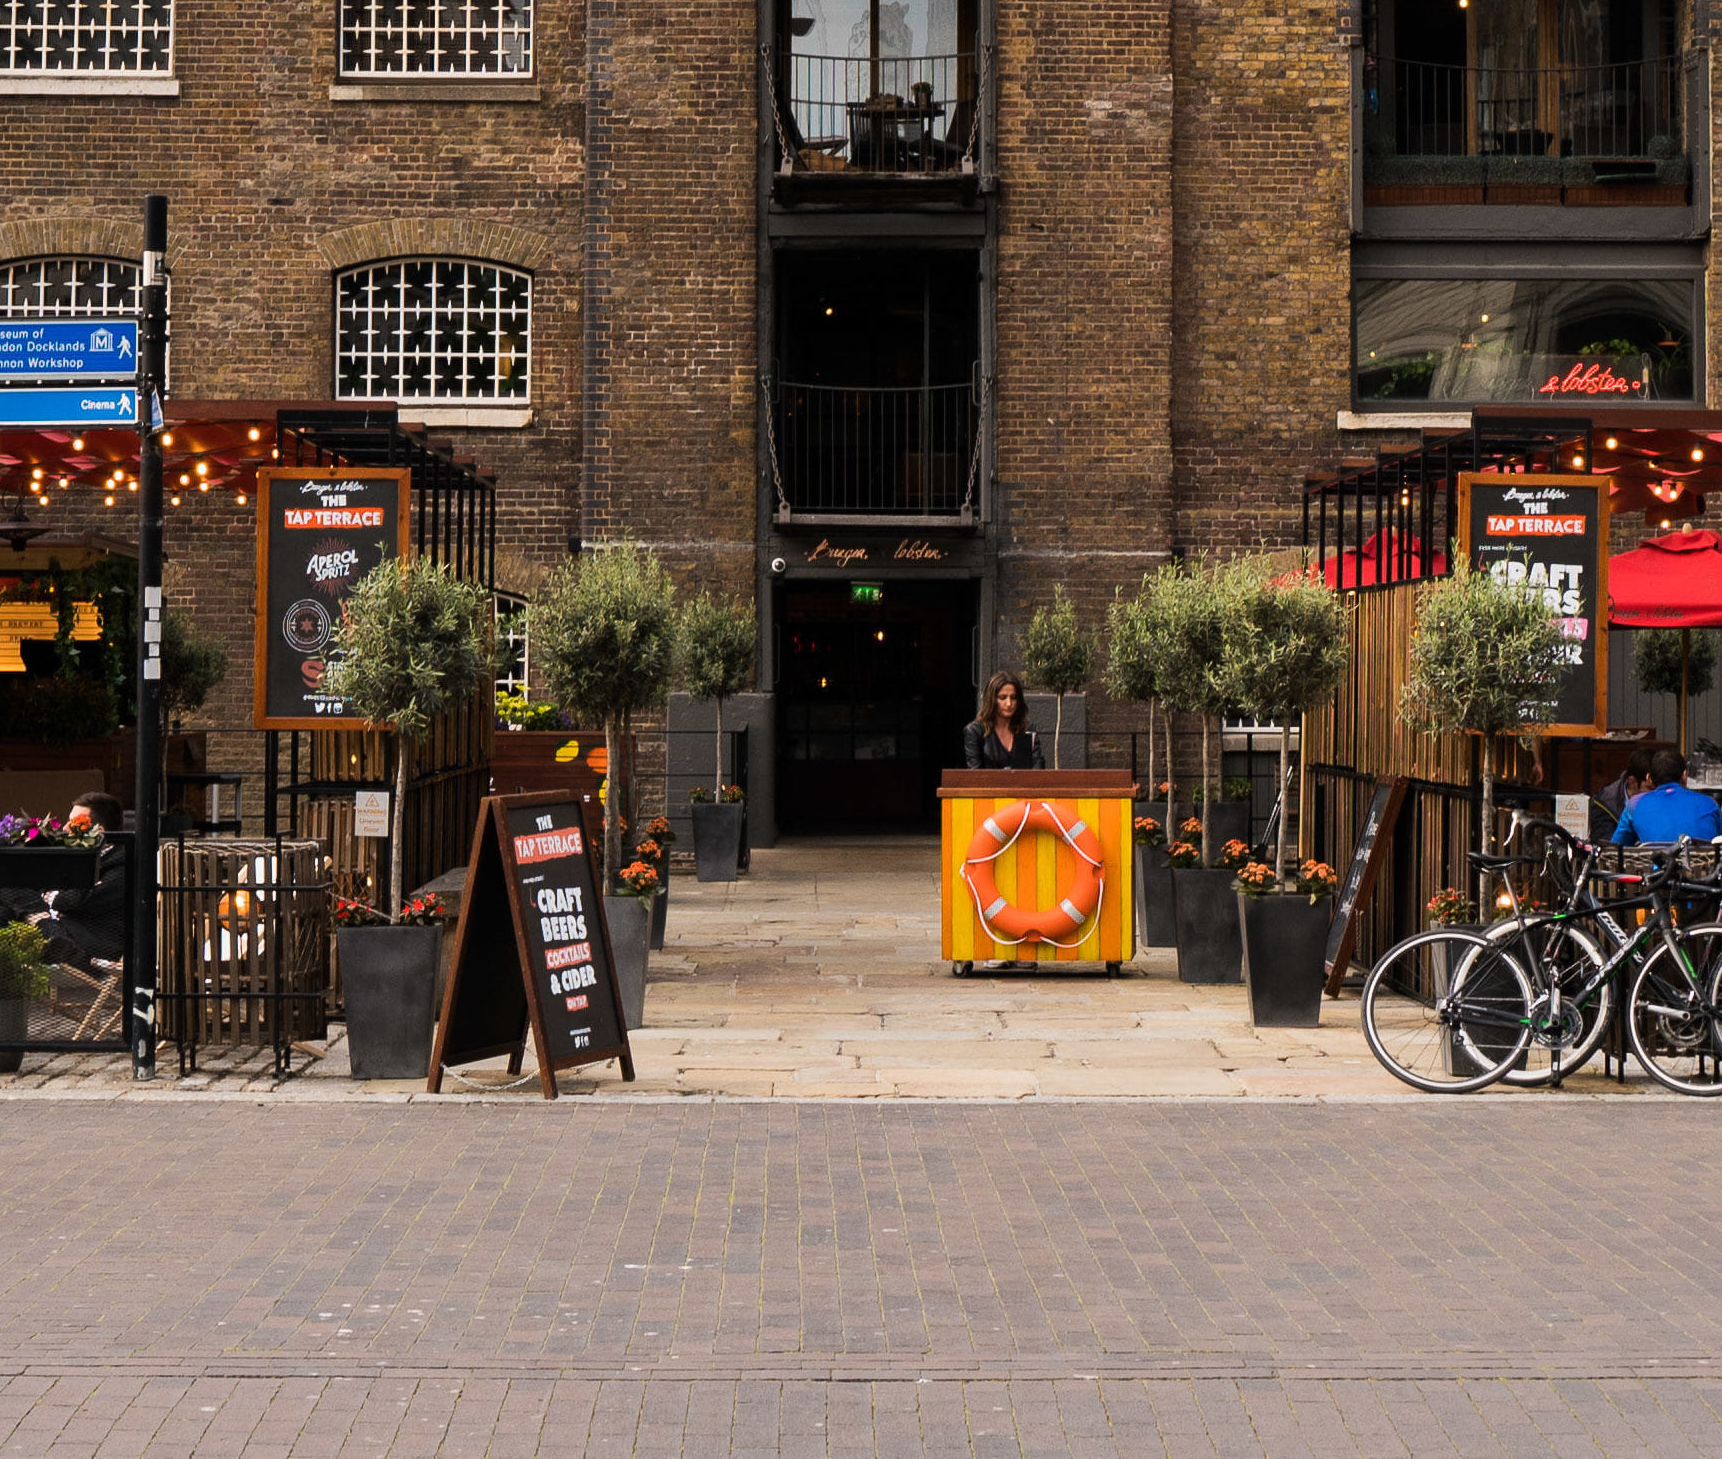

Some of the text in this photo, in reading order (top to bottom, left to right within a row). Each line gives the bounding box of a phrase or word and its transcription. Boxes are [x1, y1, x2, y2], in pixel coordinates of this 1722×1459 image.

[32, 328, 44, 338] of
[27, 340, 85, 352] Docklands
[28, 357, 84, 370] Workshop
[1539, 375, 1559, 393] &
[1561, 362, 1629, 395] lobster
[80, 399, 116, 410] Cinema
[320, 494, 347, 508] THE
[1523, 502, 1548, 515] THE
[285, 511, 381, 526] TAP TERRACE
[1488, 518, 1583, 533] TAP TERRACE
[306, 549, 359, 575] APEROL
[315, 564, 350, 582] SPRITZ
[1490, 560, 1584, 590] CRAFT
[536, 814, 553, 831] THE
[515, 832, 581, 858] TAP TERRACE
[537, 887, 583, 914] CRAFT
[540, 915, 588, 942] BEERS
[546, 942, 591, 968] COCKTAILS
[550, 965, 597, 995] & CIDER
